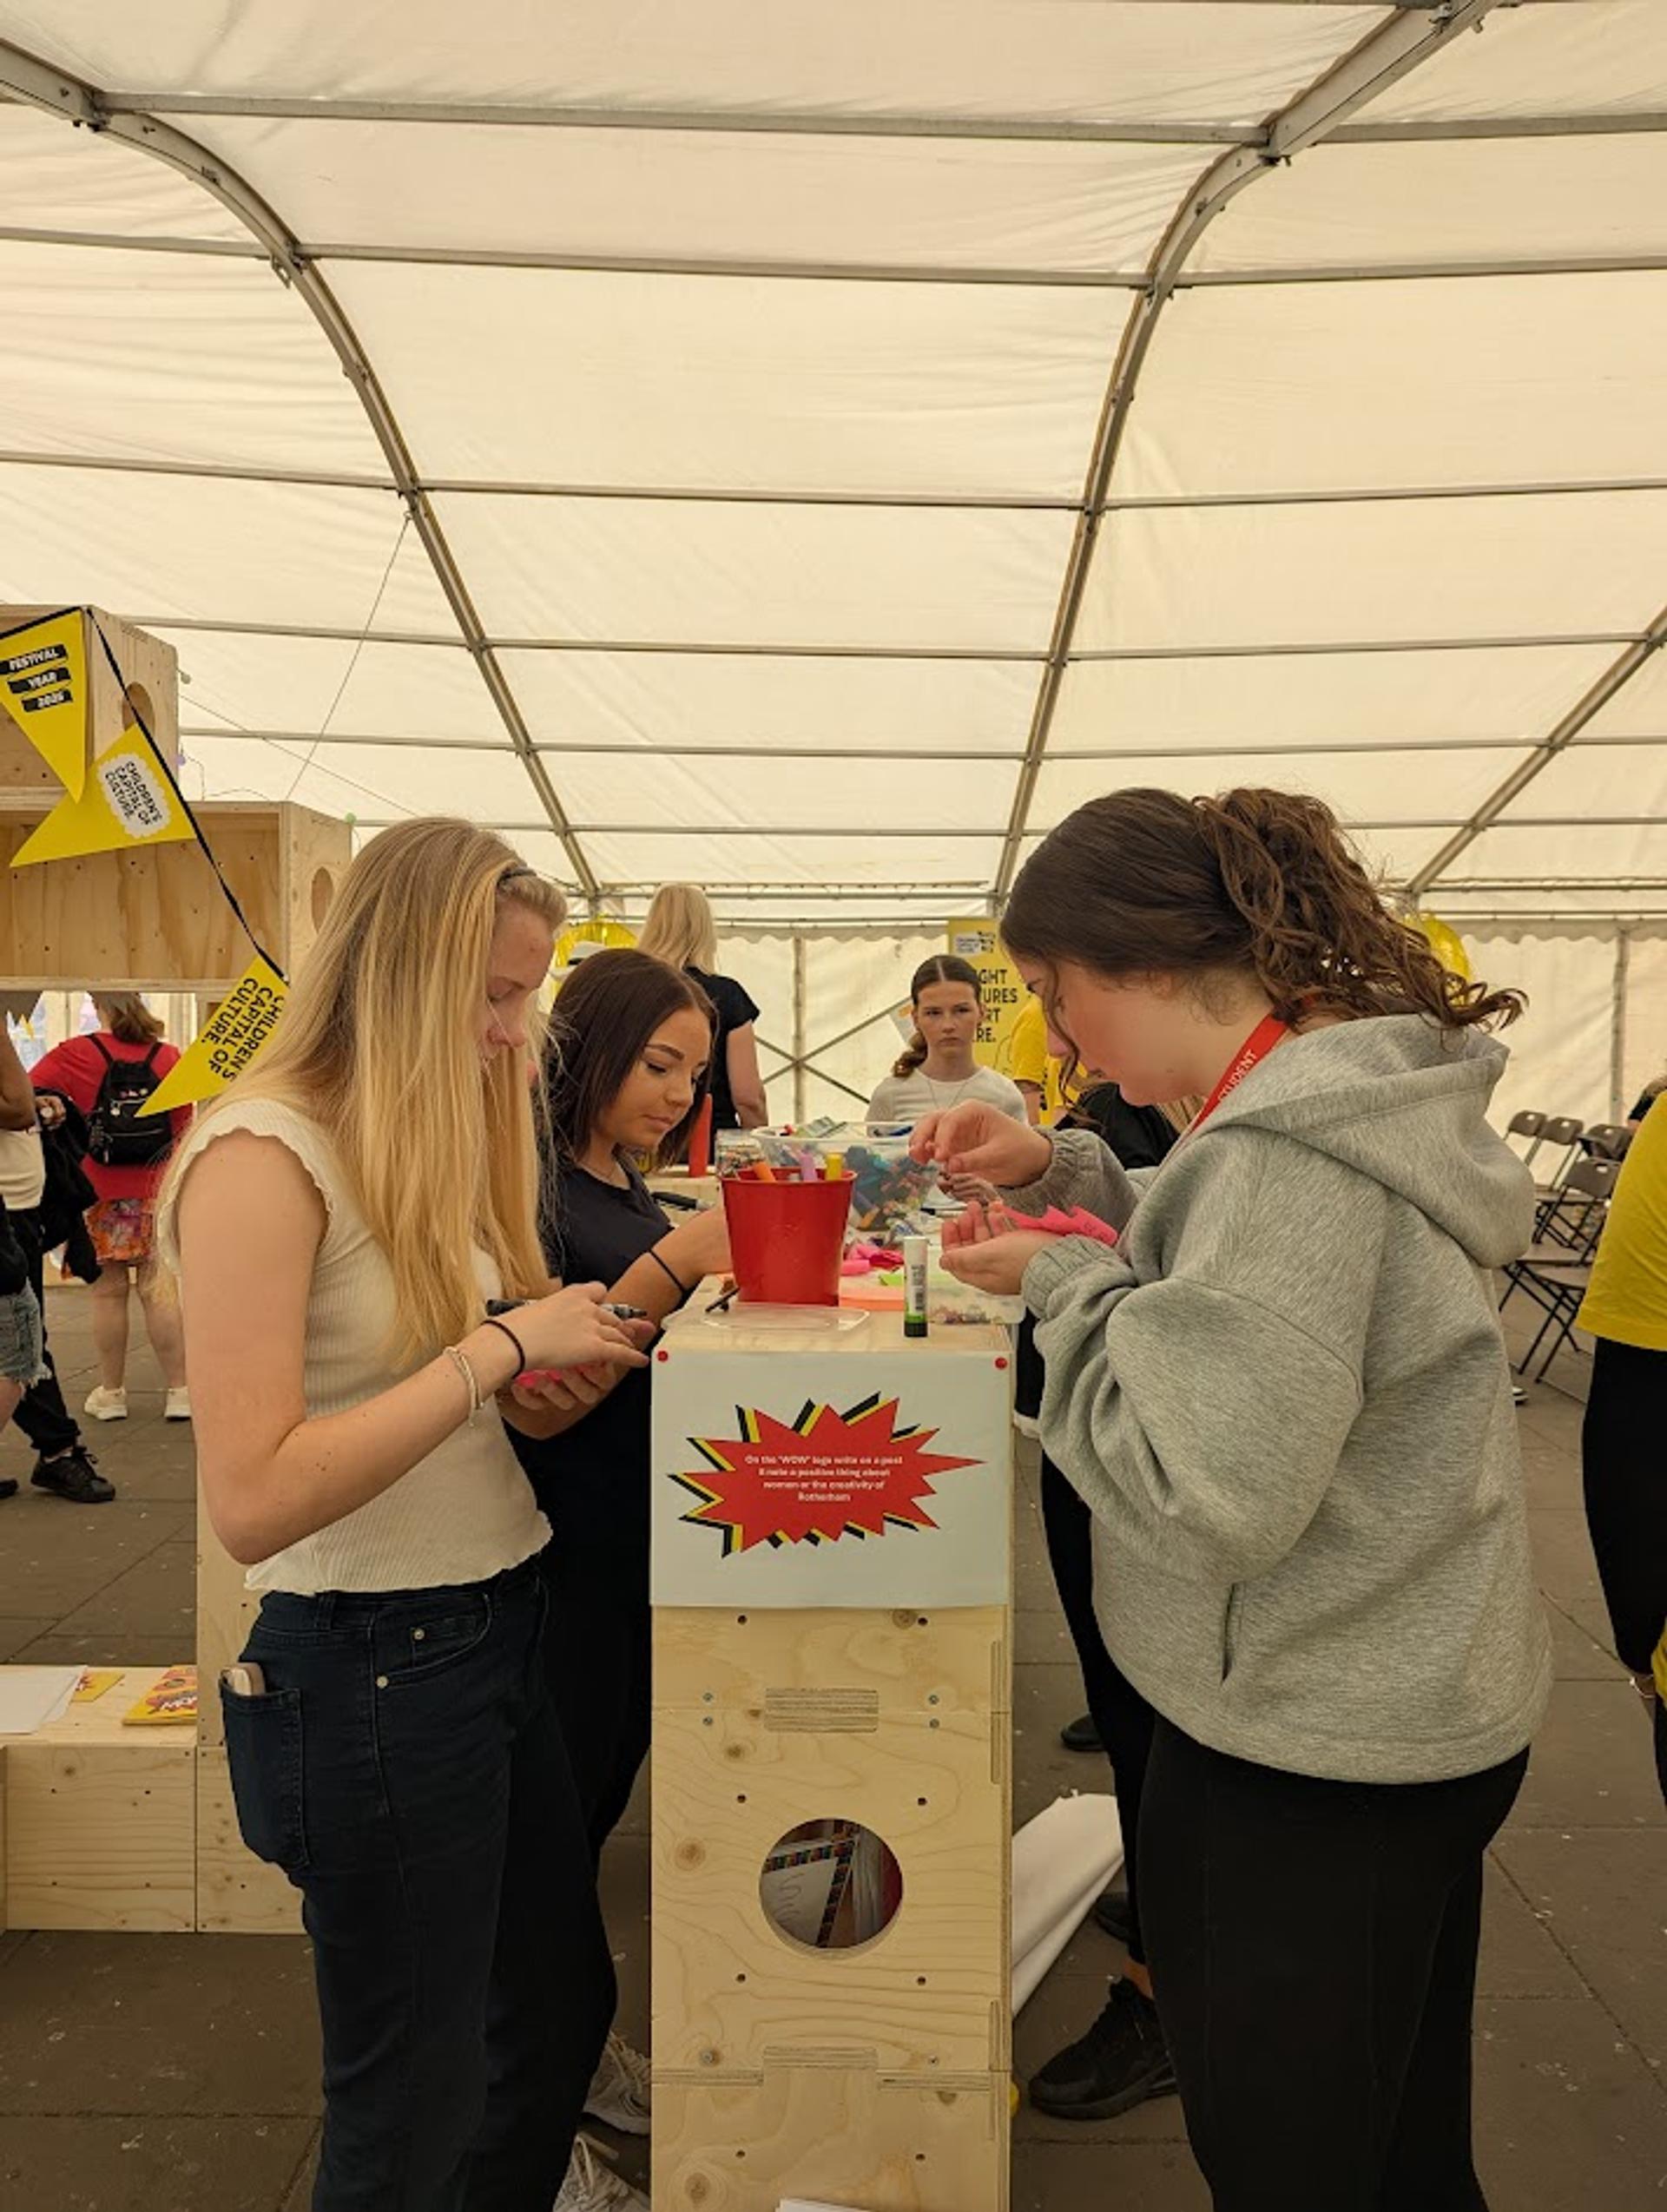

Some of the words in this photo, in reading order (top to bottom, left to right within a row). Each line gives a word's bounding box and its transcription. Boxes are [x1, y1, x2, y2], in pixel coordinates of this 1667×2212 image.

[9, 647, 60, 671] FESTIVAL
[28, 671, 57, 688] YEAR
[114, 766, 142, 809] CAPITAL
[137, 809, 153, 826] OF
[221, 987, 273, 1047] CAPITAL
[208, 1049, 229, 1074] OF
[798, 1491, 851, 1502] Rotherham
